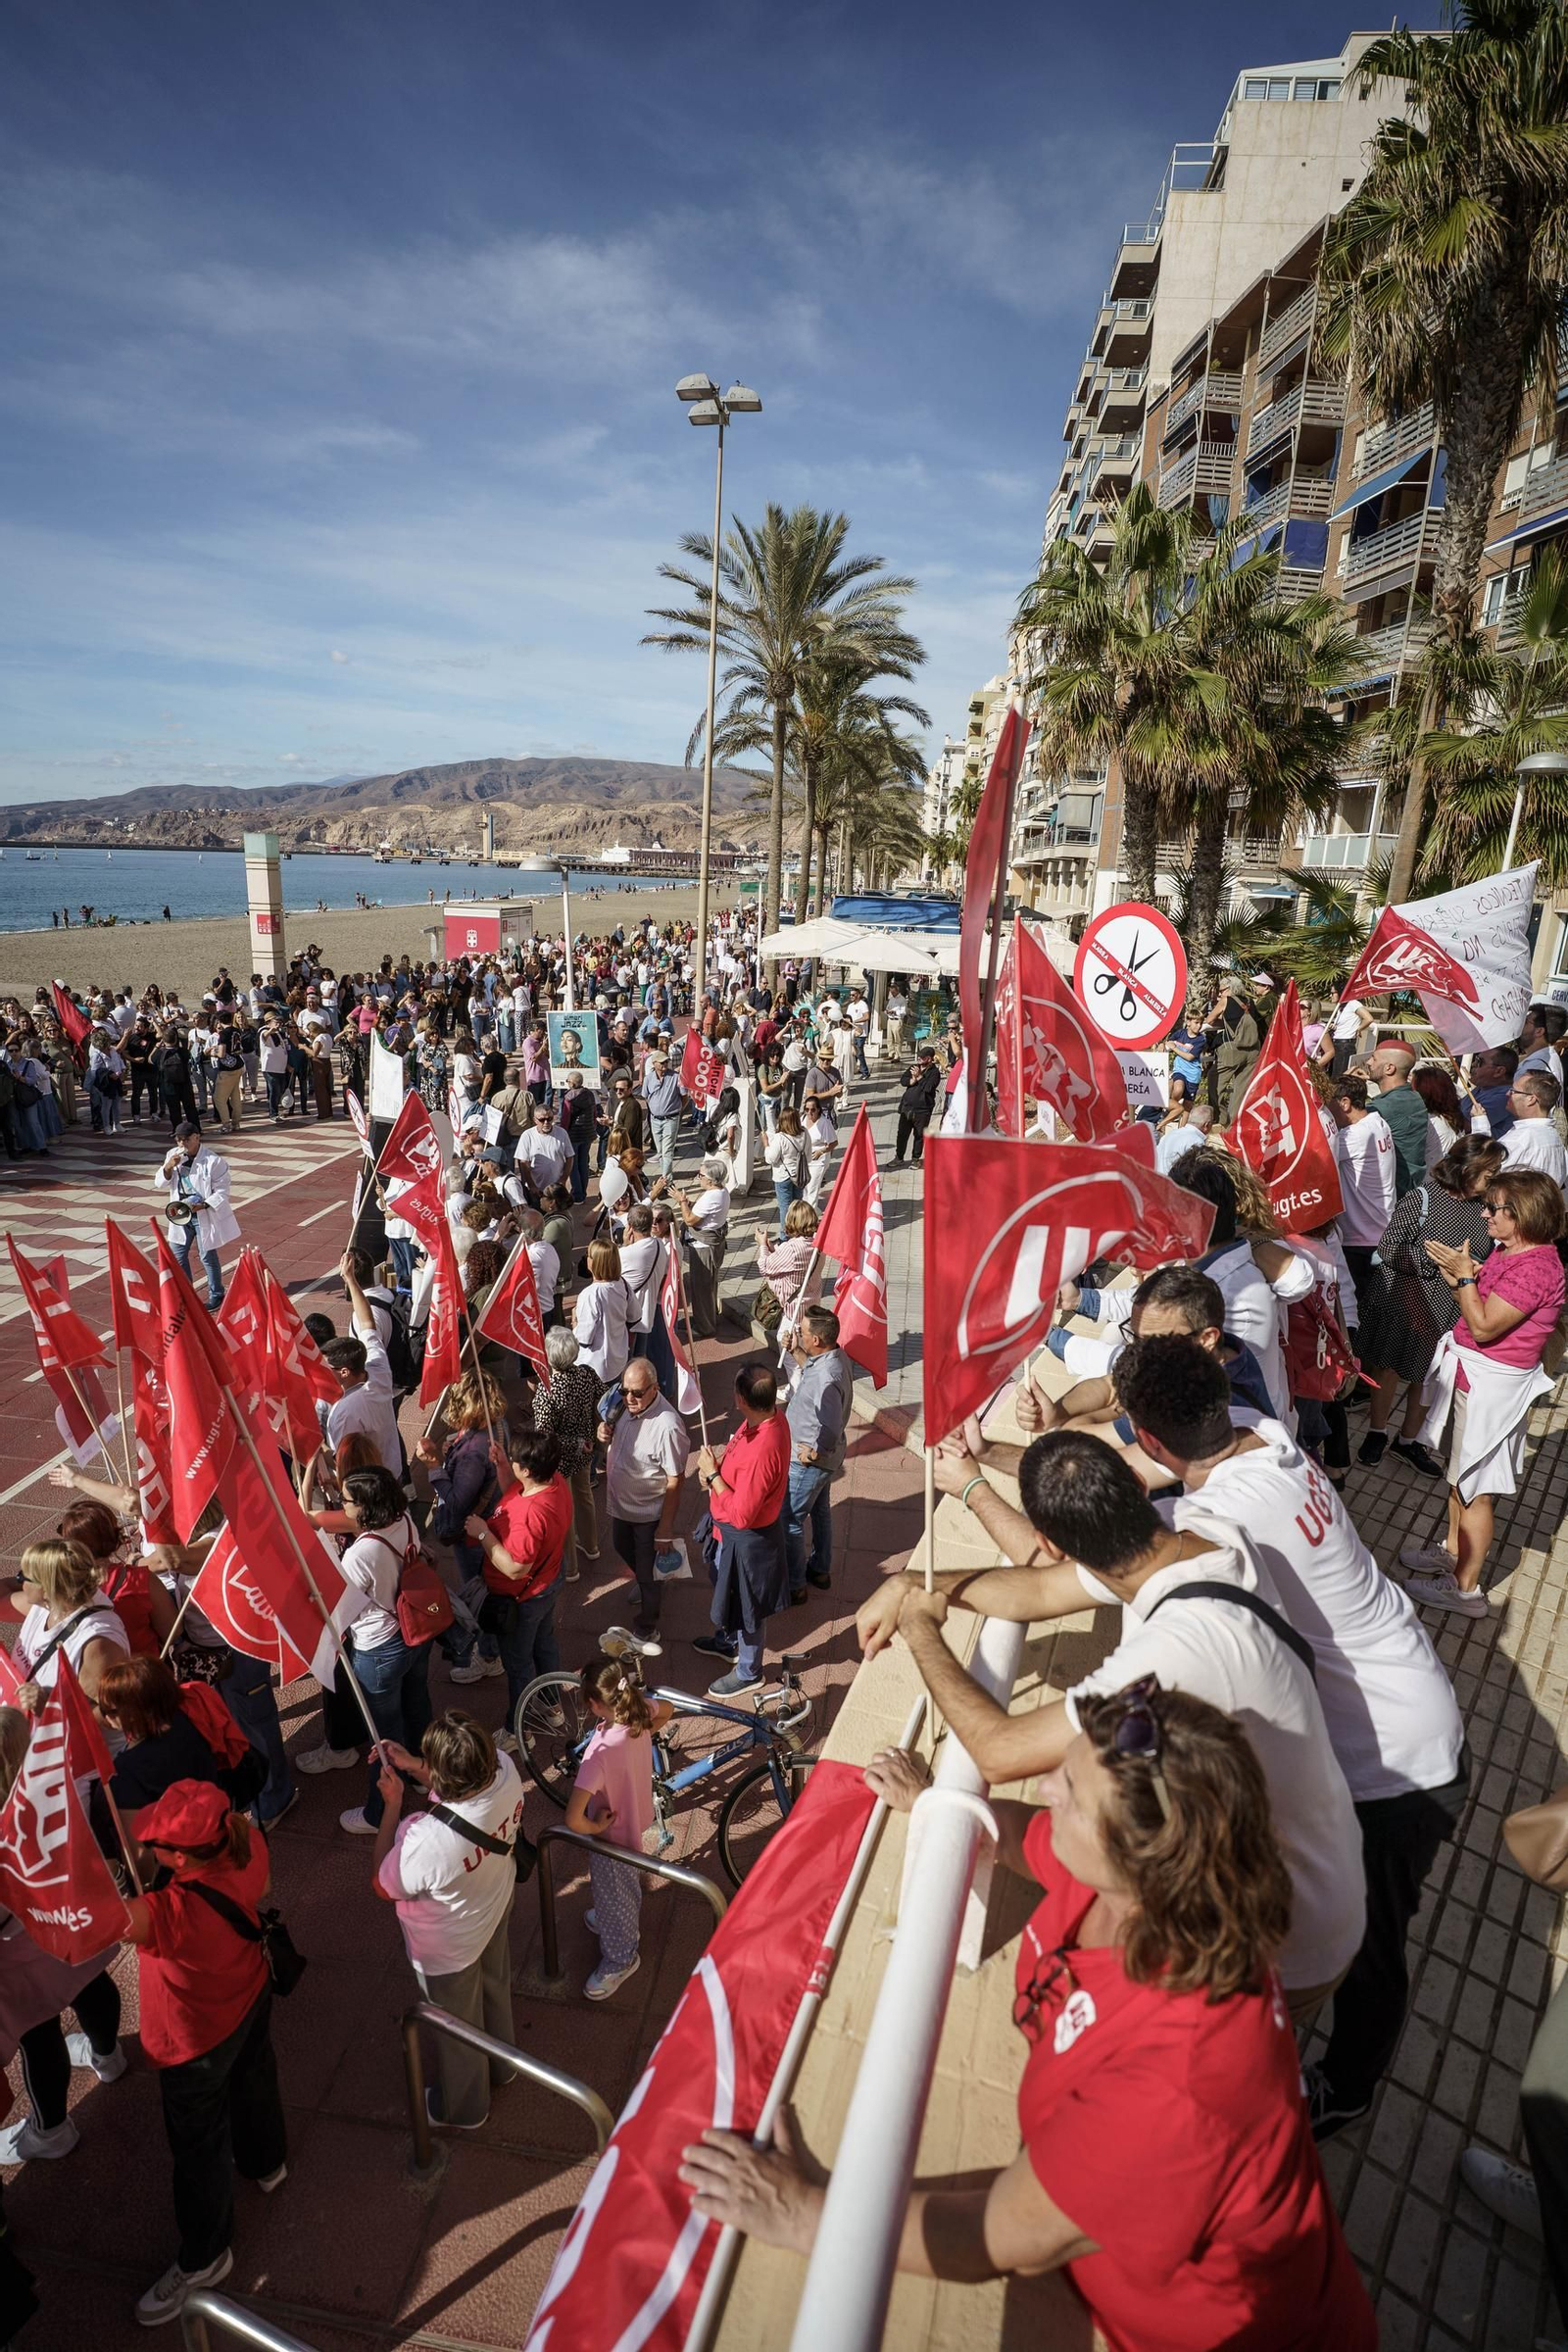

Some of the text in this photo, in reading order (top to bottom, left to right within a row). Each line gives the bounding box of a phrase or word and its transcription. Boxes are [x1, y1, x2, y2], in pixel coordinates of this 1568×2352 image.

[1091, 942, 1167, 1017] MAREA BLANCA ALMERÍA
[1129, 1065, 1165, 1078] BLANCA
[1125, 1081, 1151, 1095] ERÍA
